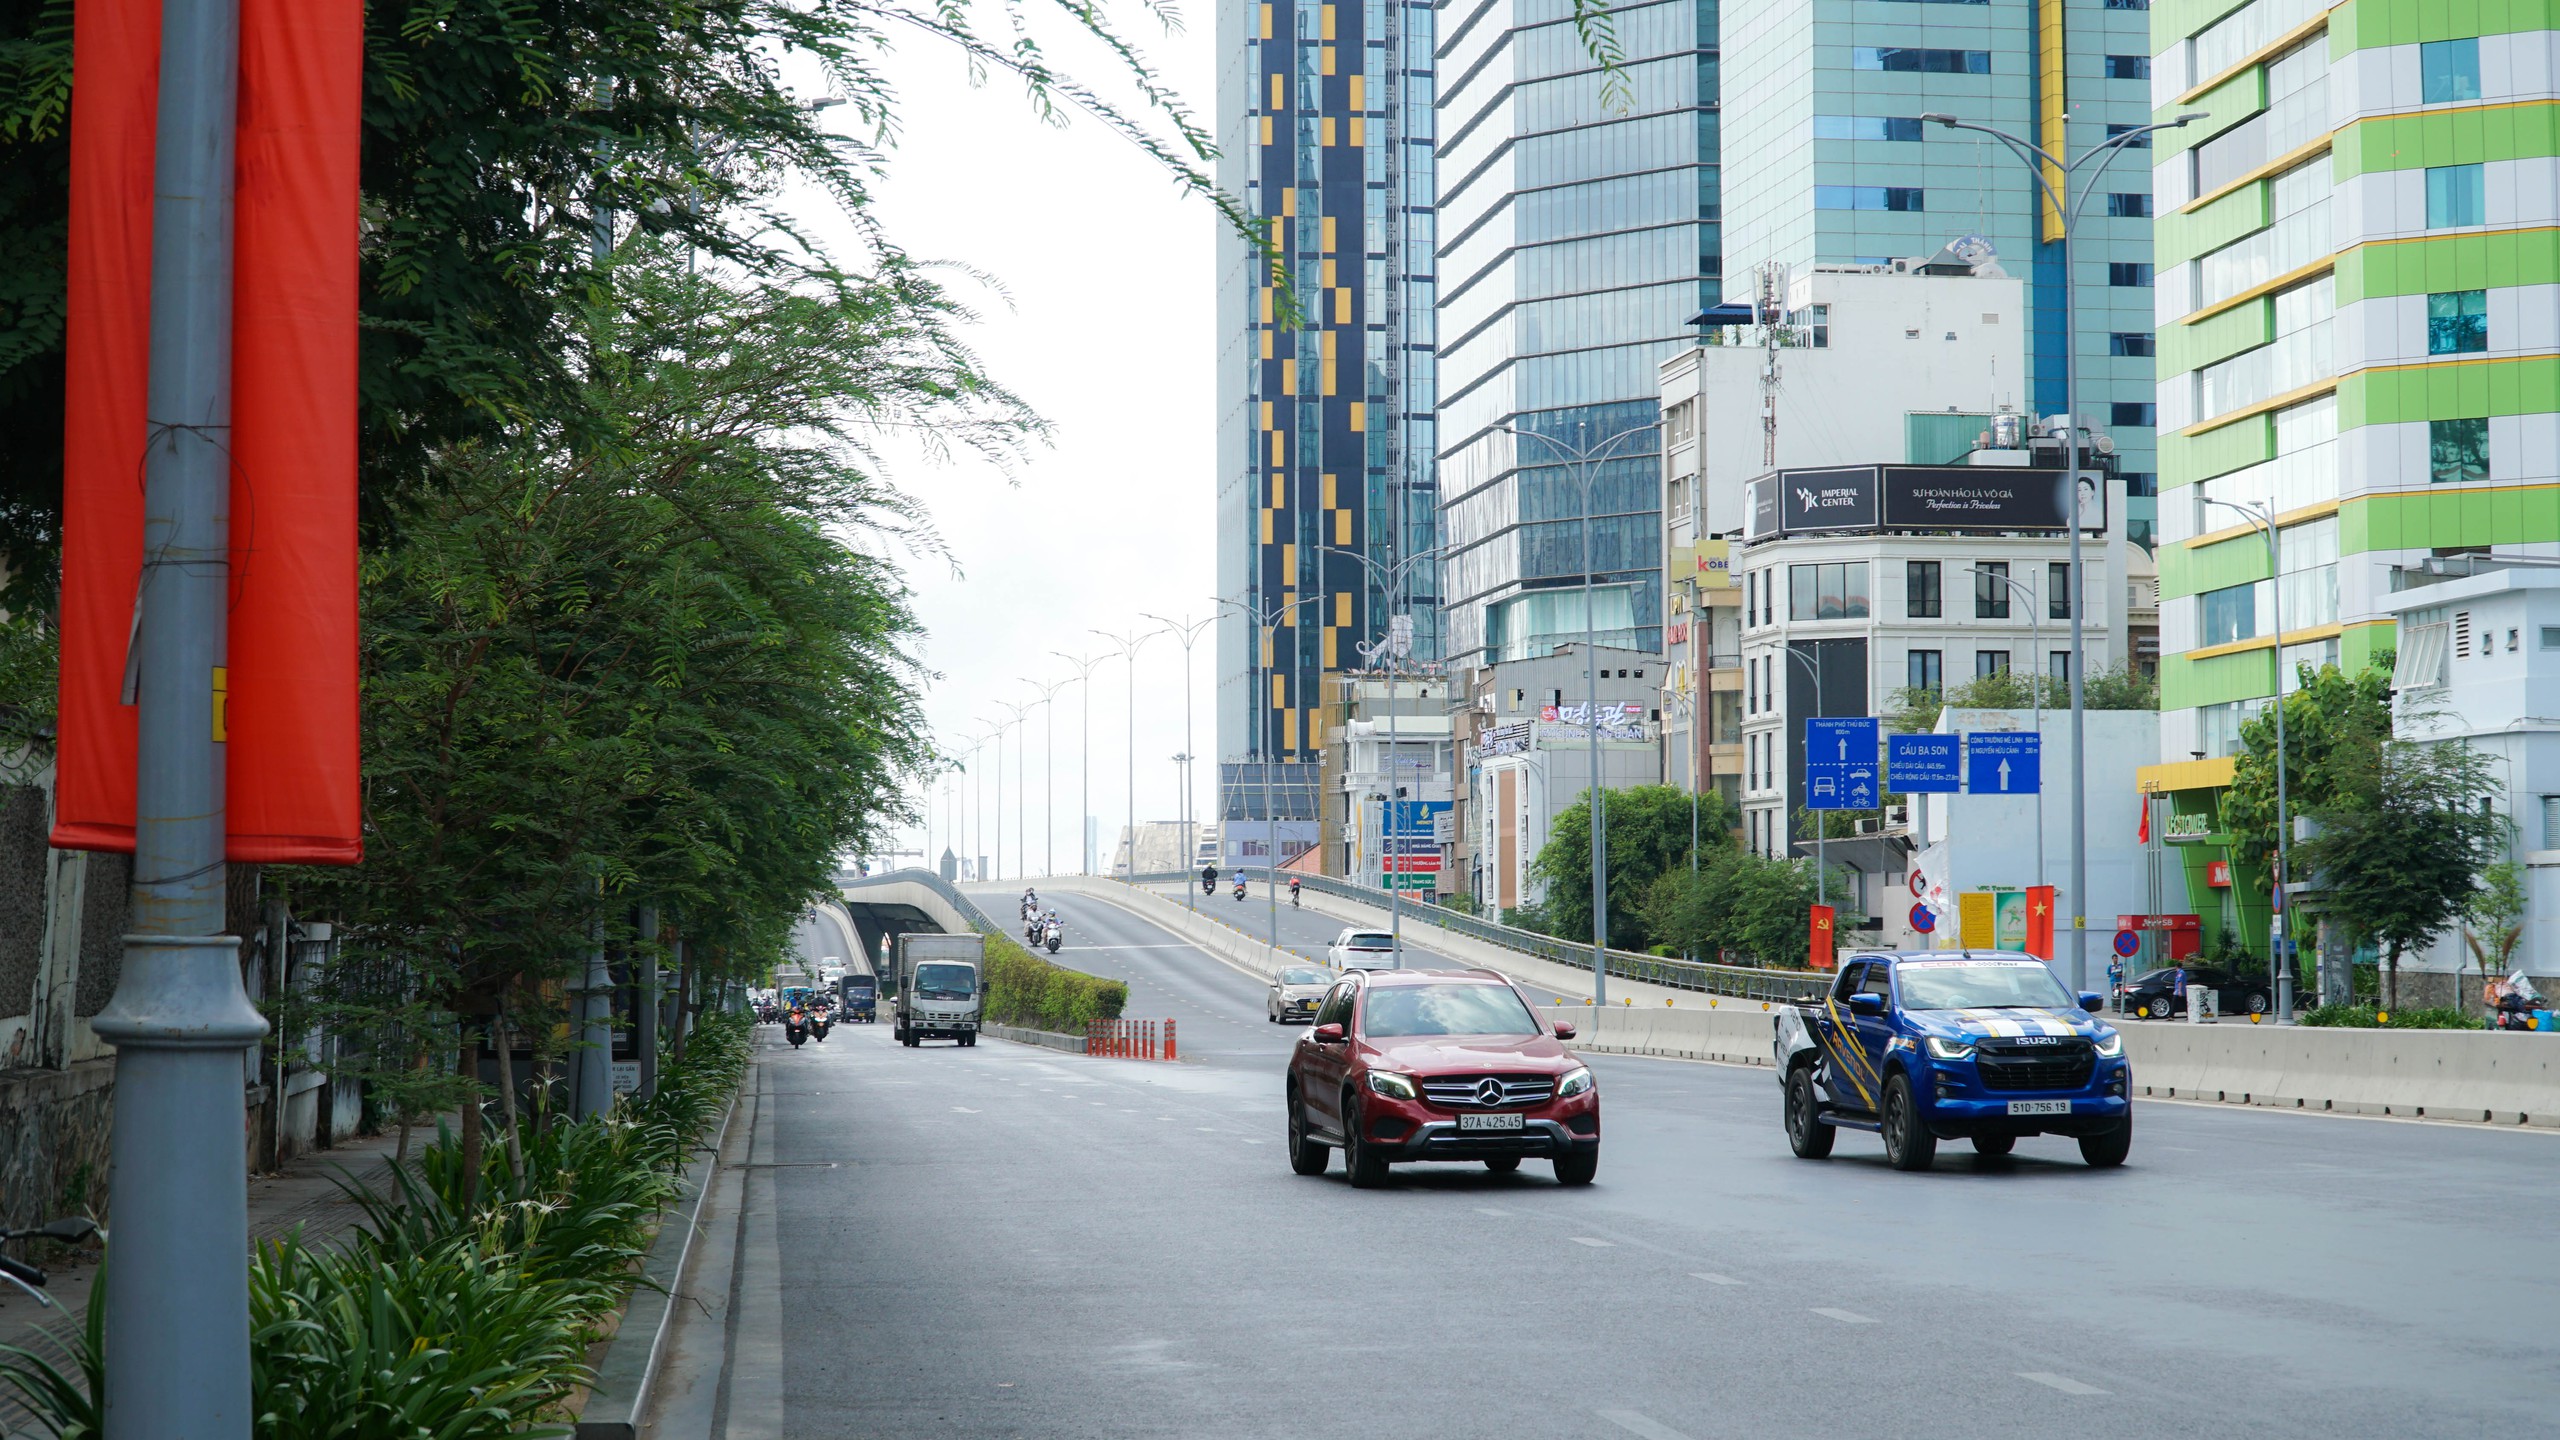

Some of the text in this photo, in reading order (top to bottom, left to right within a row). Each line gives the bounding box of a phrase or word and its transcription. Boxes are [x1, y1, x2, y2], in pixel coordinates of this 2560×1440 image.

[1821, 488, 1859, 498] IMPERIAL
[1912, 487, 2013, 499] SỰ HOÀN HẢO LÀ VÔ GIÁ
[1821, 498, 1855, 507] CENTER
[1925, 499, 2001, 511] Perfection is Priceless
[1815, 720, 1833, 728] THÀNH
[1834, 720, 1846, 728] PHỐ
[1858, 720, 1870, 728] ĐỨC
[1918, 745, 1930, 756] BA
[1930, 745, 1948, 756] SON
[2015, 1037, 2057, 1045] ISUZU
[1462, 1116, 1521, 1129] 37A-425.45
